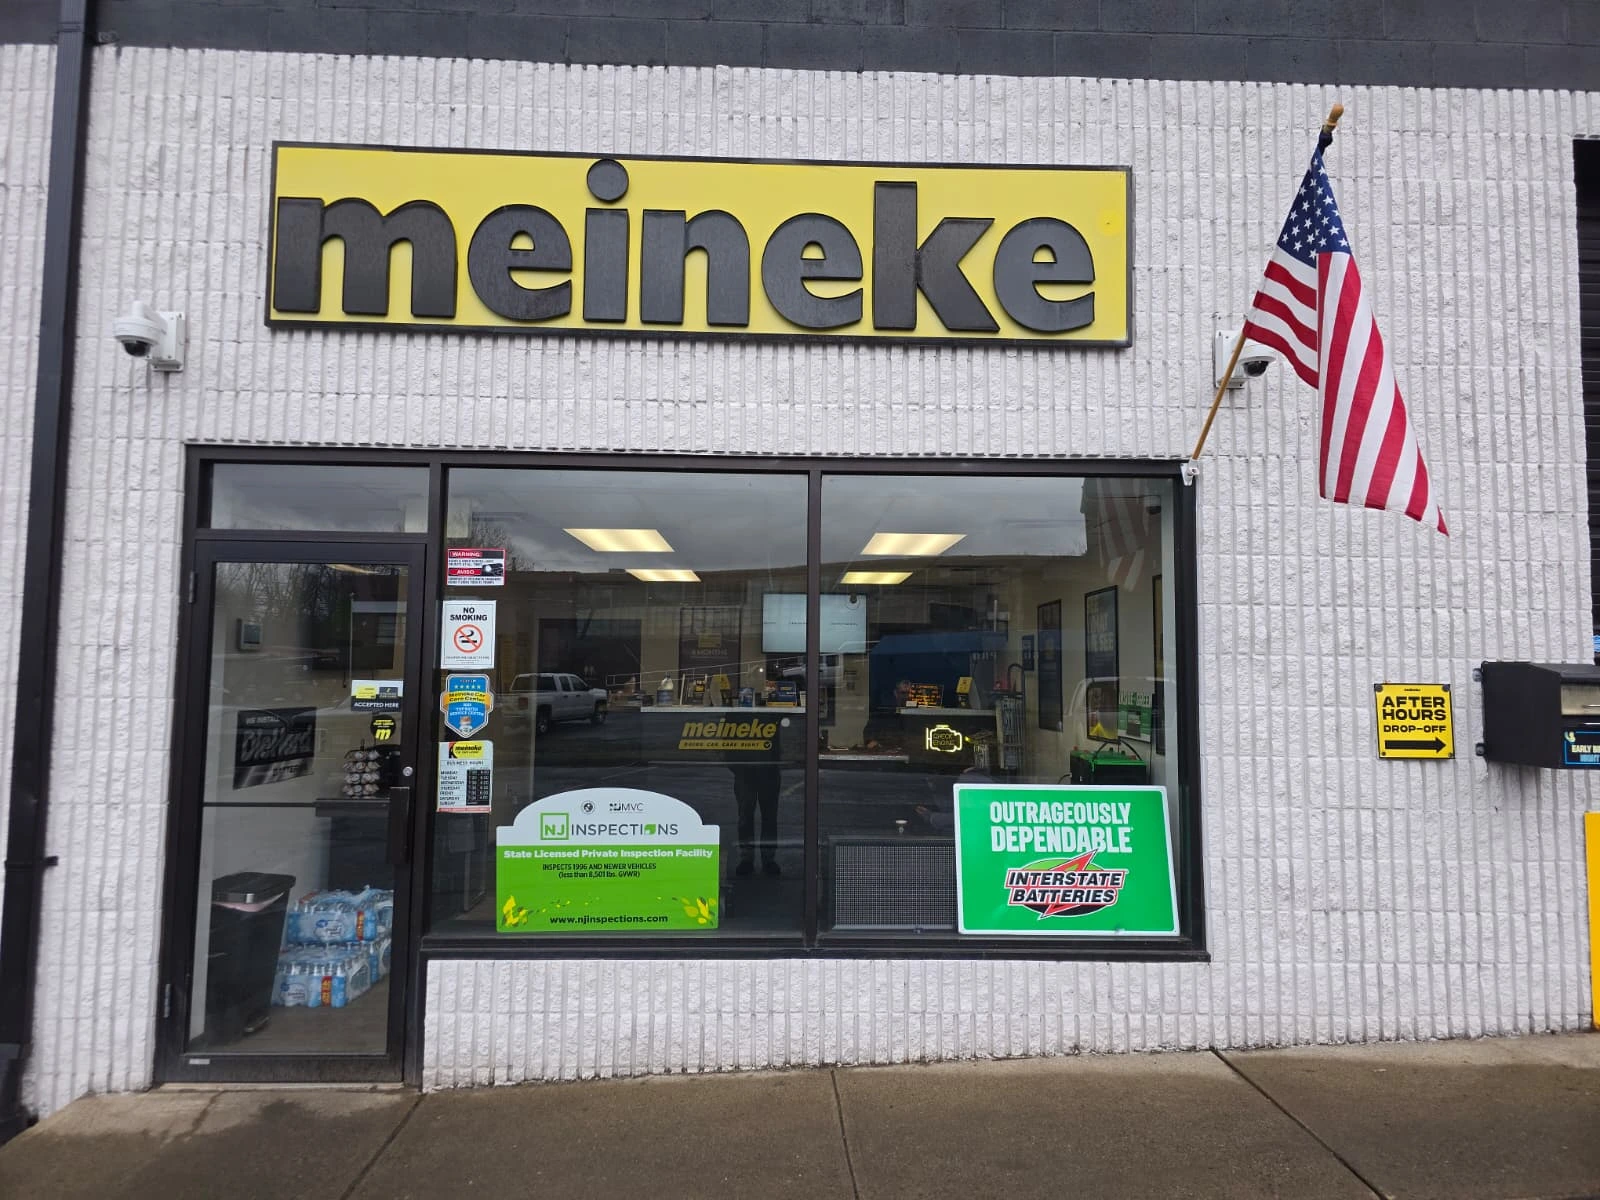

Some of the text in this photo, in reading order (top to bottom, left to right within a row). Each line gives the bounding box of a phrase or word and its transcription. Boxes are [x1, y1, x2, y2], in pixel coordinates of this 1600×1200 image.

[277, 158, 1095, 333] meineke
[1382, 696, 1445, 708] AFTER
[1382, 709, 1446, 720] HOURS
[682, 718, 777, 738] meineke
[1384, 725, 1446, 733] DROP-OFF
[990, 801, 1131, 825] OUTRAGEOUSLY
[544, 824, 565, 836] NJ
[991, 826, 1132, 853] DEPENDABLE
[504, 848, 713, 858] State Licensed Private Inspection Facility
[1008, 872, 1122, 886] INTERSTATE
[1012, 888, 1115, 903] BATTERIES
[550, 914, 668, 925] www.njinspections.com
